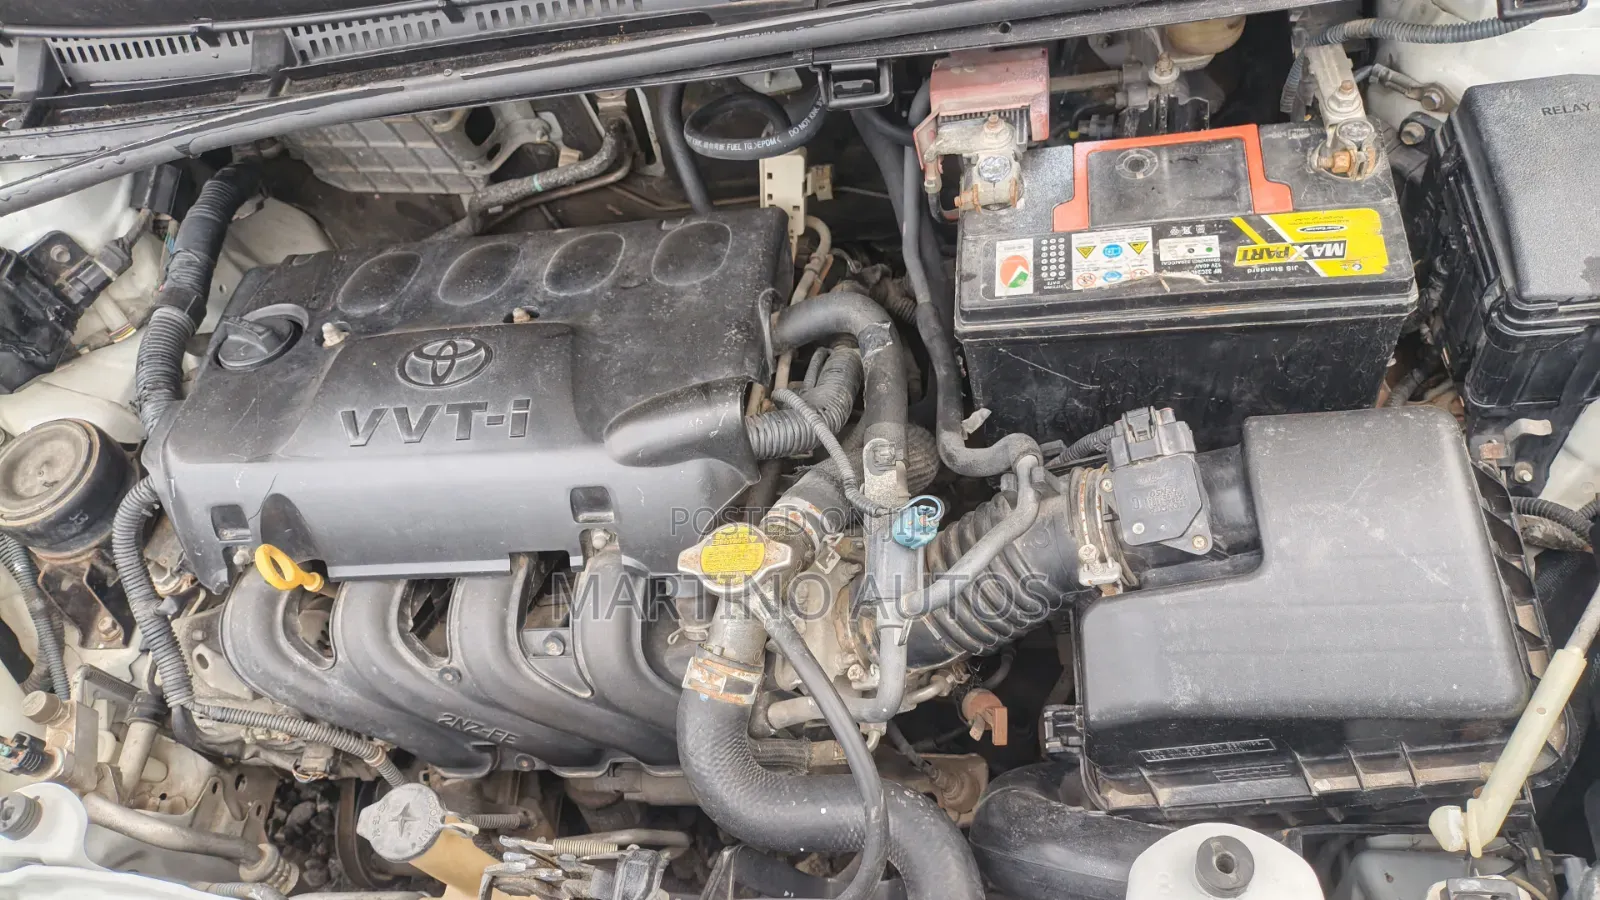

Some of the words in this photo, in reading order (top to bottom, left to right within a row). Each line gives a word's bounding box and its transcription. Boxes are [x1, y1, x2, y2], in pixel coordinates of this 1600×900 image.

[1541, 102, 1591, 116] RELAY
[788, 127, 800, 137] DO
[798, 119, 811, 131] NOT
[726, 143, 742, 151] FUEL
[1246, 265, 1285, 275] Standard
[340, 398, 532, 447] VVT-i
[438, 712, 520, 745] 2NZ-FE
